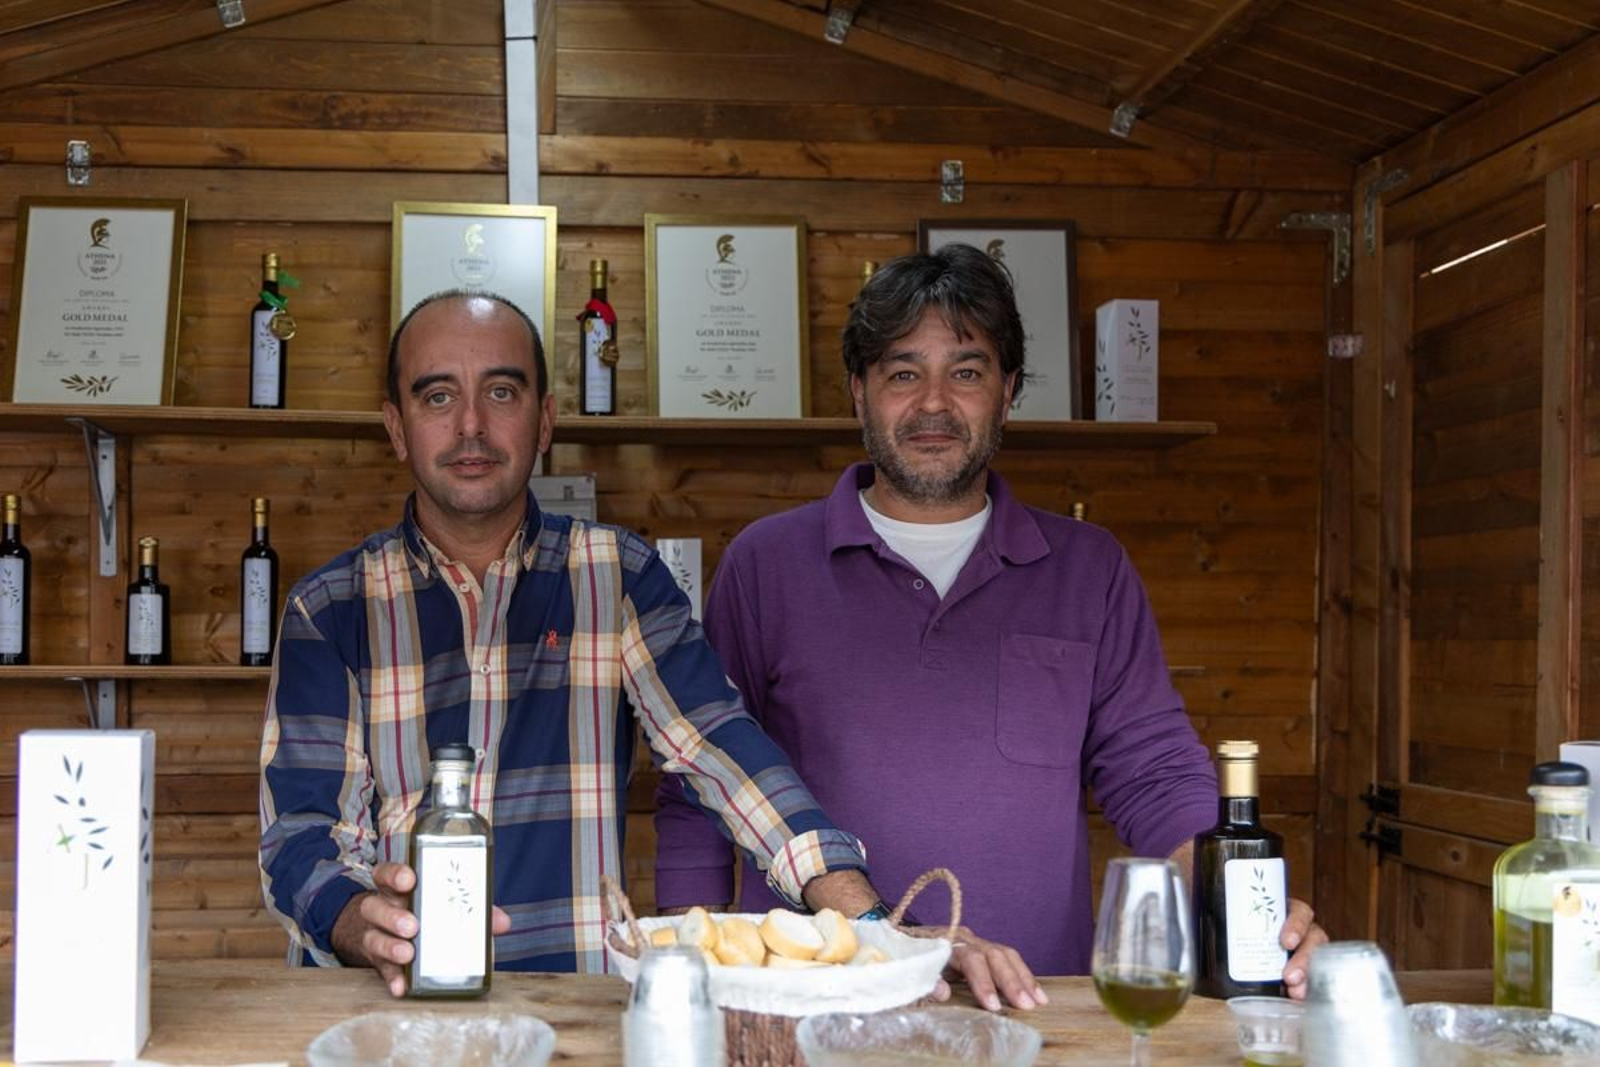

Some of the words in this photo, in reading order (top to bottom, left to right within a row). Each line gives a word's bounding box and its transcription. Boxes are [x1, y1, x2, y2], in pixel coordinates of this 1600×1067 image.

[79, 289, 115, 298] DIPLOMA
[710, 304, 745, 313] DIPLOMA
[62, 313, 91, 322] GOLD
[92, 313, 128, 322] MEDAL
[696, 329, 725, 338] GOLD
[726, 329, 760, 338] MEDAL
